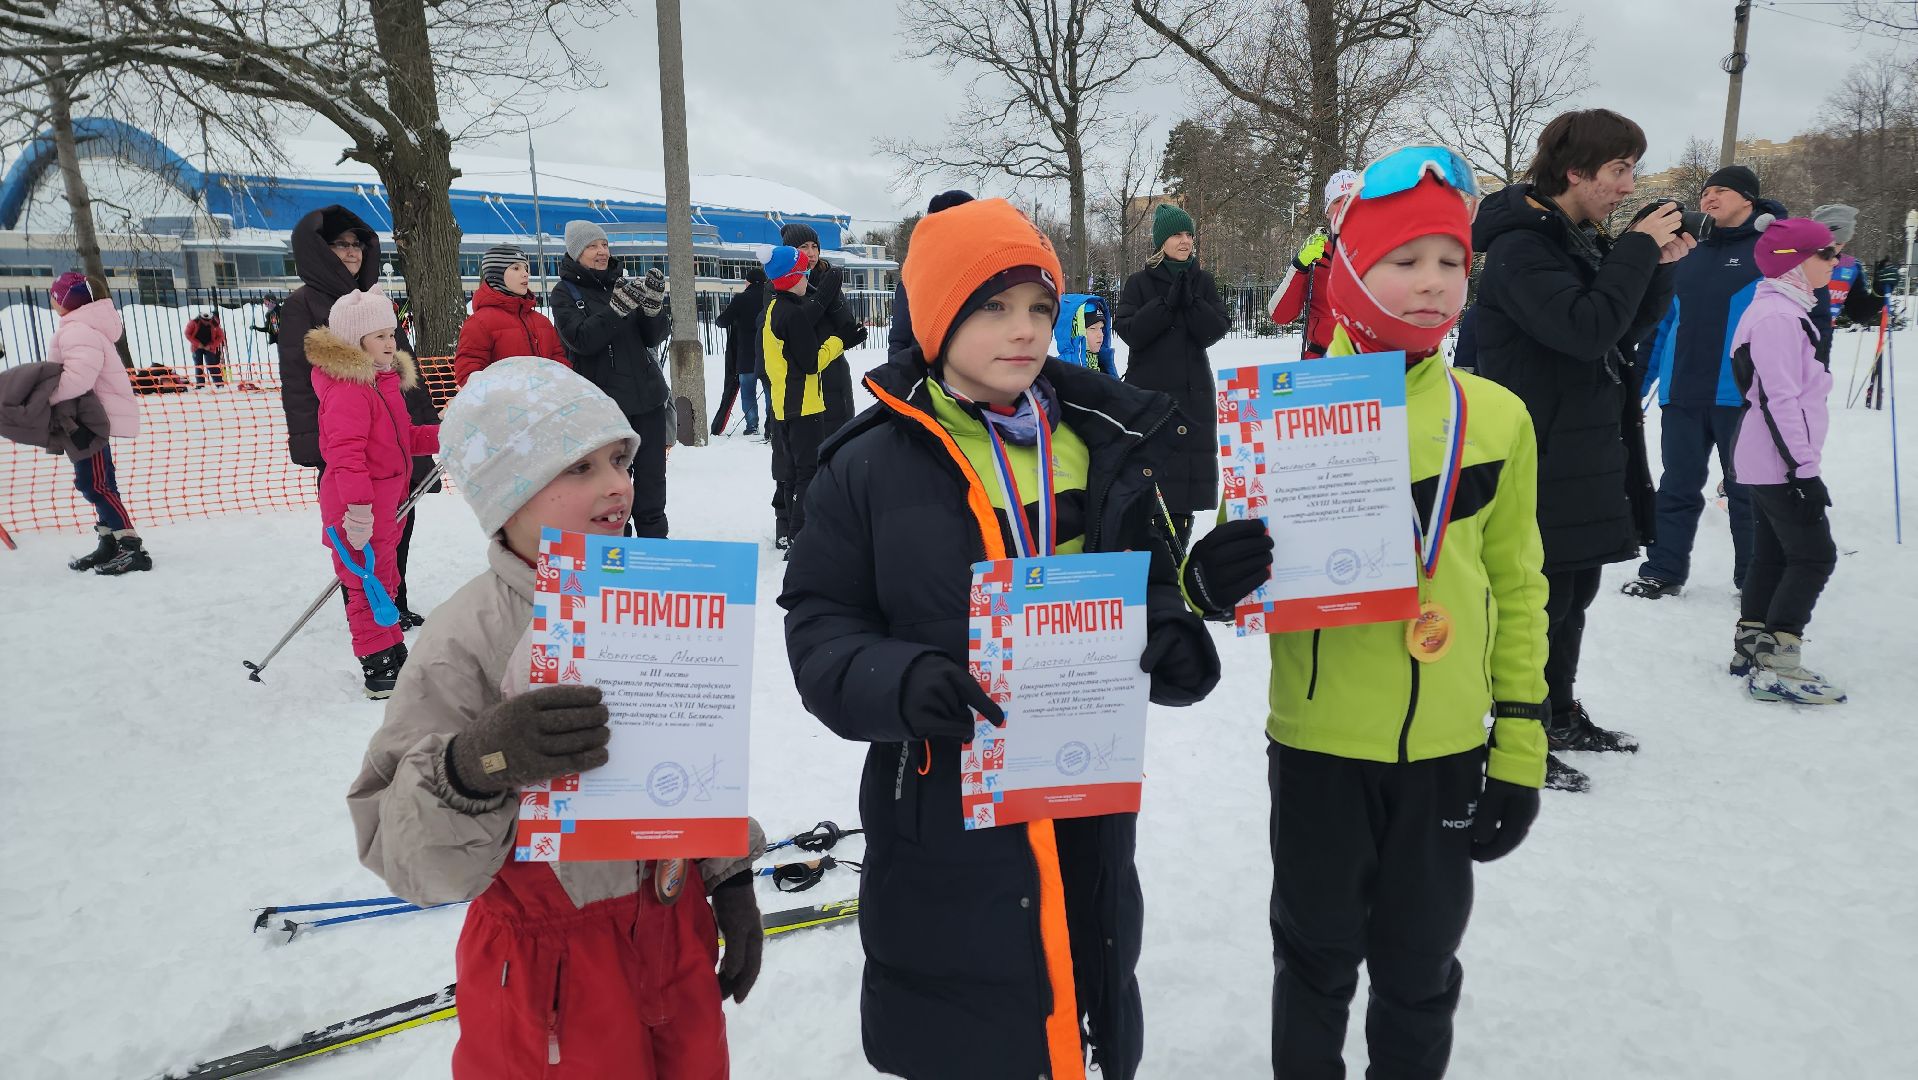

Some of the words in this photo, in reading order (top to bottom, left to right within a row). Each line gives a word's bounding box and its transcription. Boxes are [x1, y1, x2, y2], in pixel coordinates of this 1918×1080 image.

[1275, 400, 1380, 440] ГРАМОТА
[602, 589, 725, 629] ГРАМОТА
[1025, 599, 1123, 636] ГРАМОТА
[671, 649, 724, 663] Михаил
[649, 668, 662, 677] III
[1068, 669, 1075, 678] II
[594, 677, 643, 687] Открытого
[617, 688, 653, 697] Ступино
[656, 690, 701, 699] Московской
[697, 702, 735, 711] Мемориал
[1442, 818, 1474, 829] NOR
